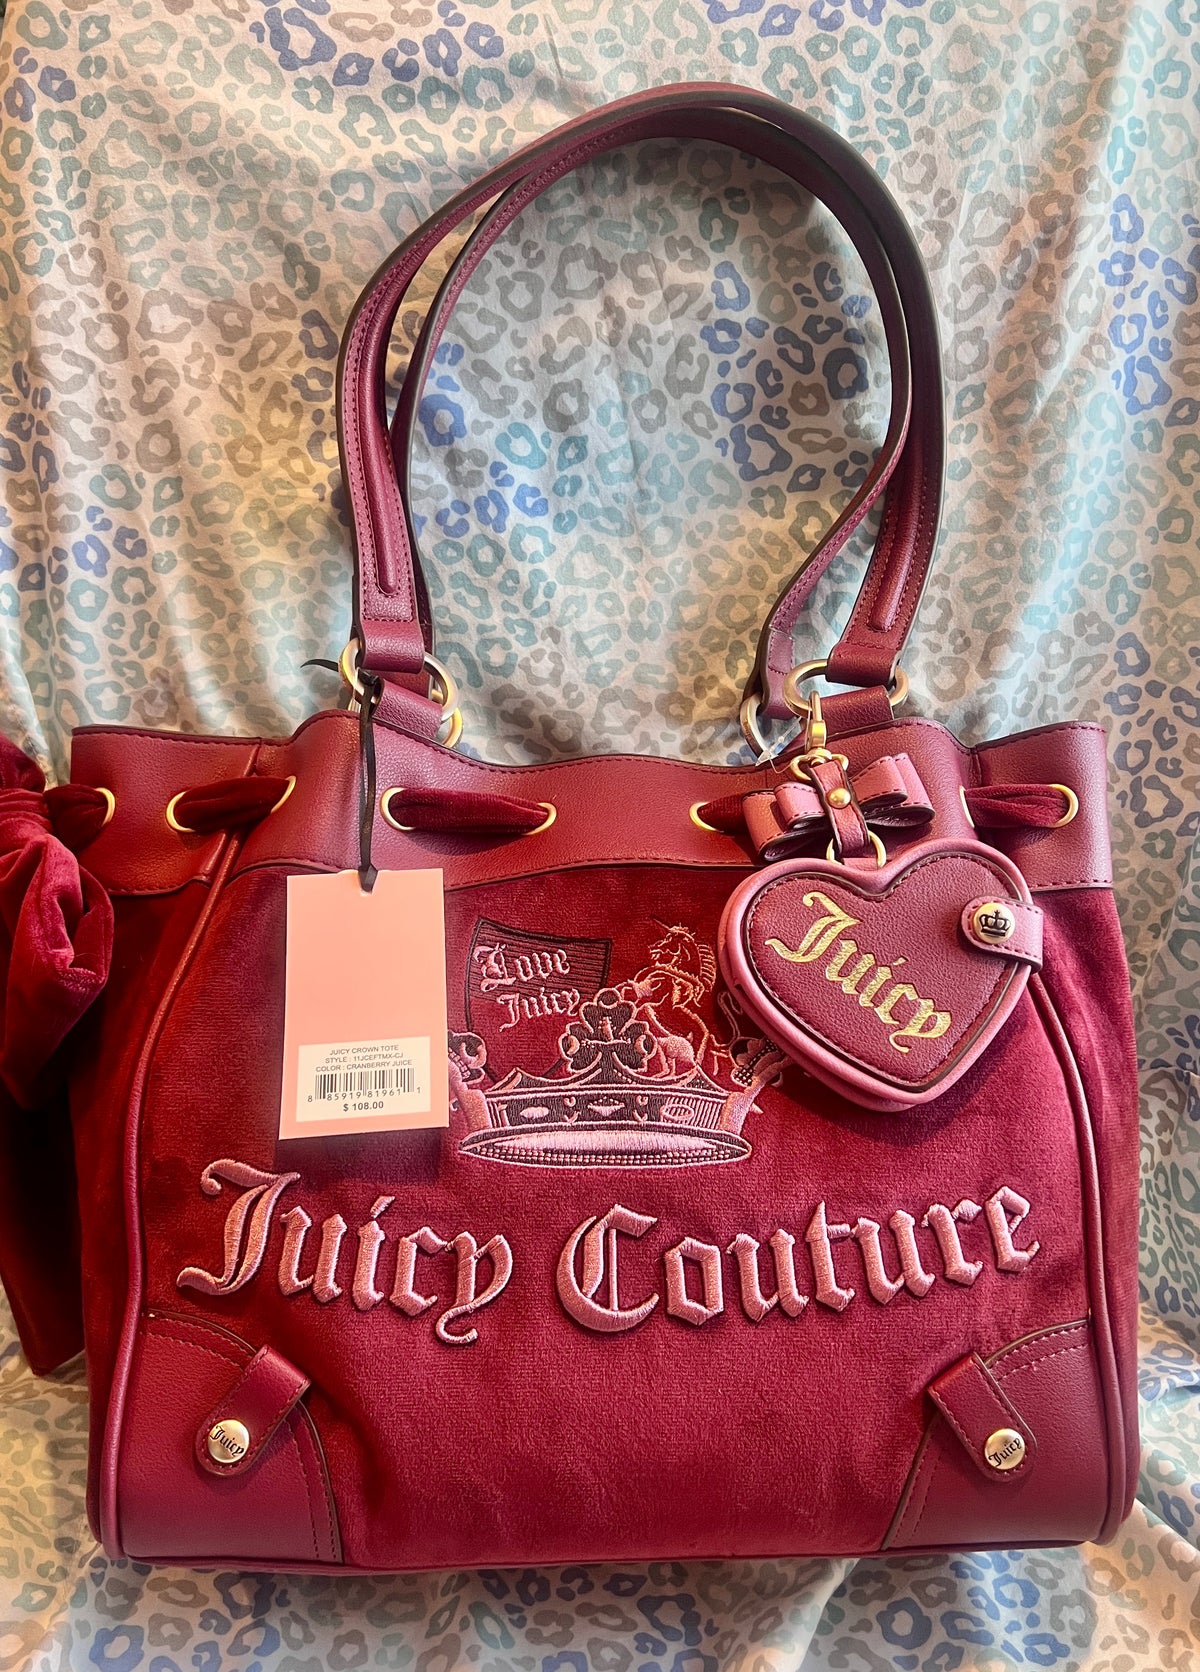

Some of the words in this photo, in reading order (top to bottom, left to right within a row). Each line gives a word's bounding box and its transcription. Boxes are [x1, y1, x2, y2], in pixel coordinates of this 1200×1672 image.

[473, 943, 571, 992] Love
[764, 890, 952, 1054] Juicy
[497, 987, 580, 1032] Juicy
[325, 1056, 348, 1064] STYLE
[329, 1048, 350, 1056] JUICY
[351, 1046, 379, 1054] CROWN
[381, 1044, 399, 1052] TOTE
[315, 1065, 341, 1073] COLOR
[346, 1061, 390, 1070] CRANBERRY
[392, 1059, 413, 1067] JUICE
[307, 1095, 313, 1103] 8
[327, 1091, 362, 1101] 85919
[367, 1089, 401, 1098] 81961
[352, 1100, 384, 1111] 108.00
[176, 1158, 513, 1345] Juicy
[556, 1185, 1040, 1332] Couture
[209, 1425, 245, 1457] Juicy
[988, 1437, 1022, 1467] Juicy
